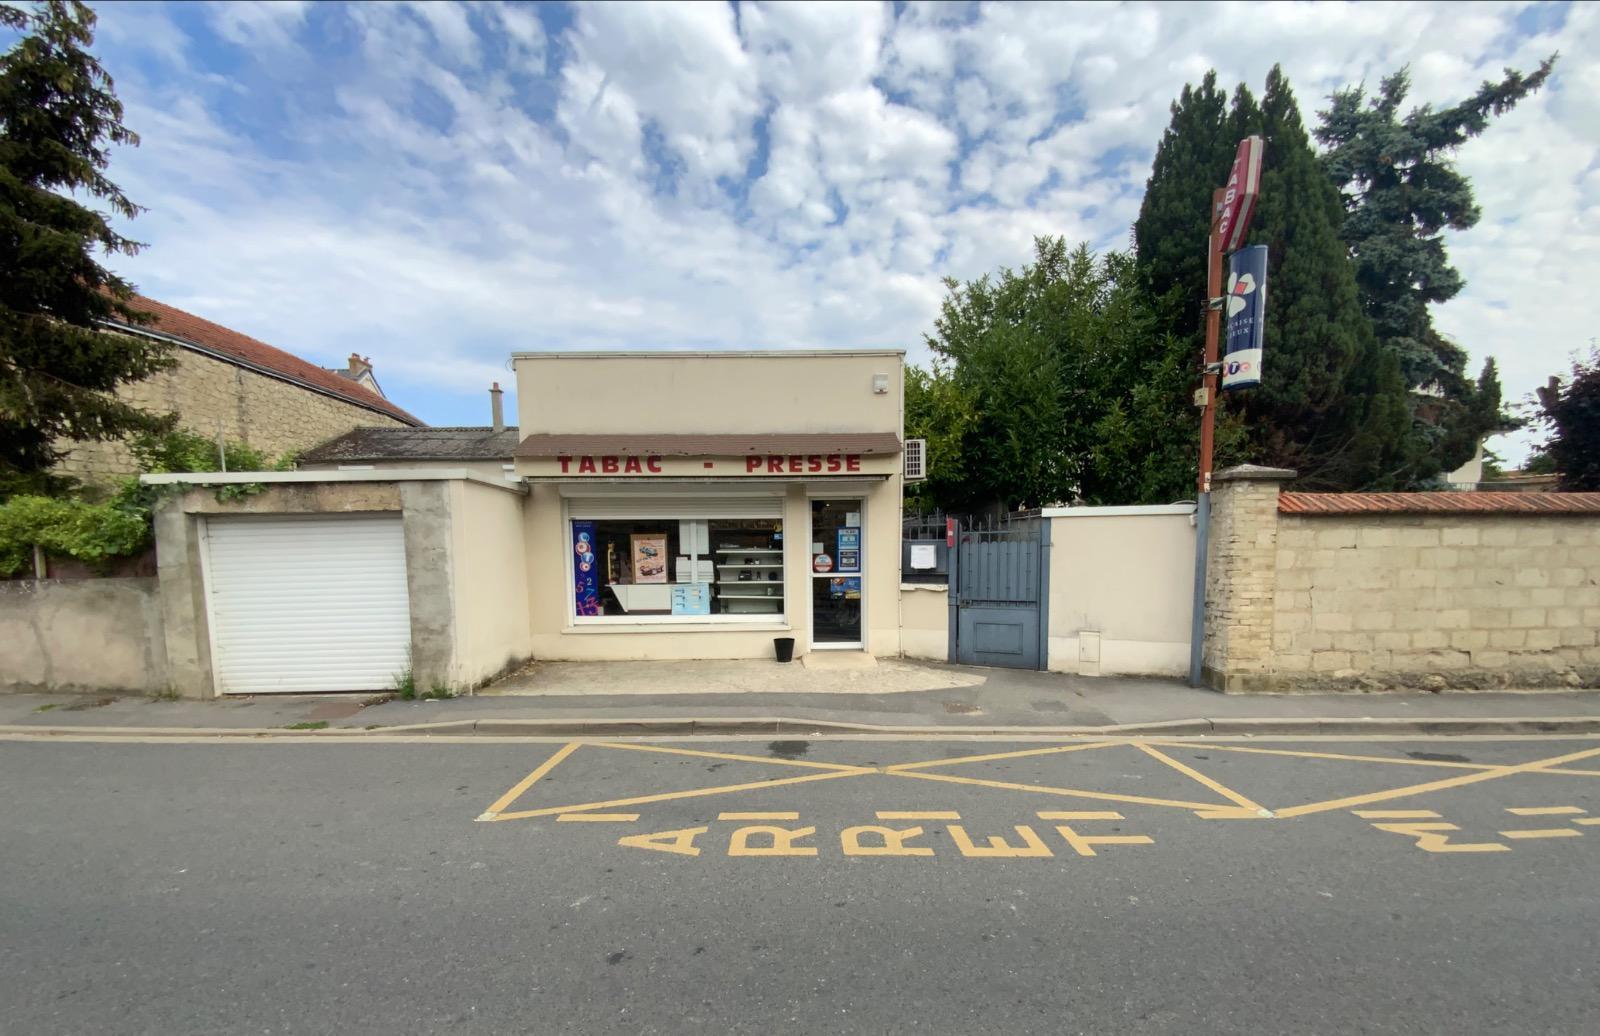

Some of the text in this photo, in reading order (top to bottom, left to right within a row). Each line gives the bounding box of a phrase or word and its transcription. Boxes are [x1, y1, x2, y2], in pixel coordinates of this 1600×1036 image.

[1219, 158, 1241, 234] TABAC
[557, 455, 662, 474] TABAC
[746, 454, 861, 473] PRESSE
[617, 825, 1155, 857] ARRET
